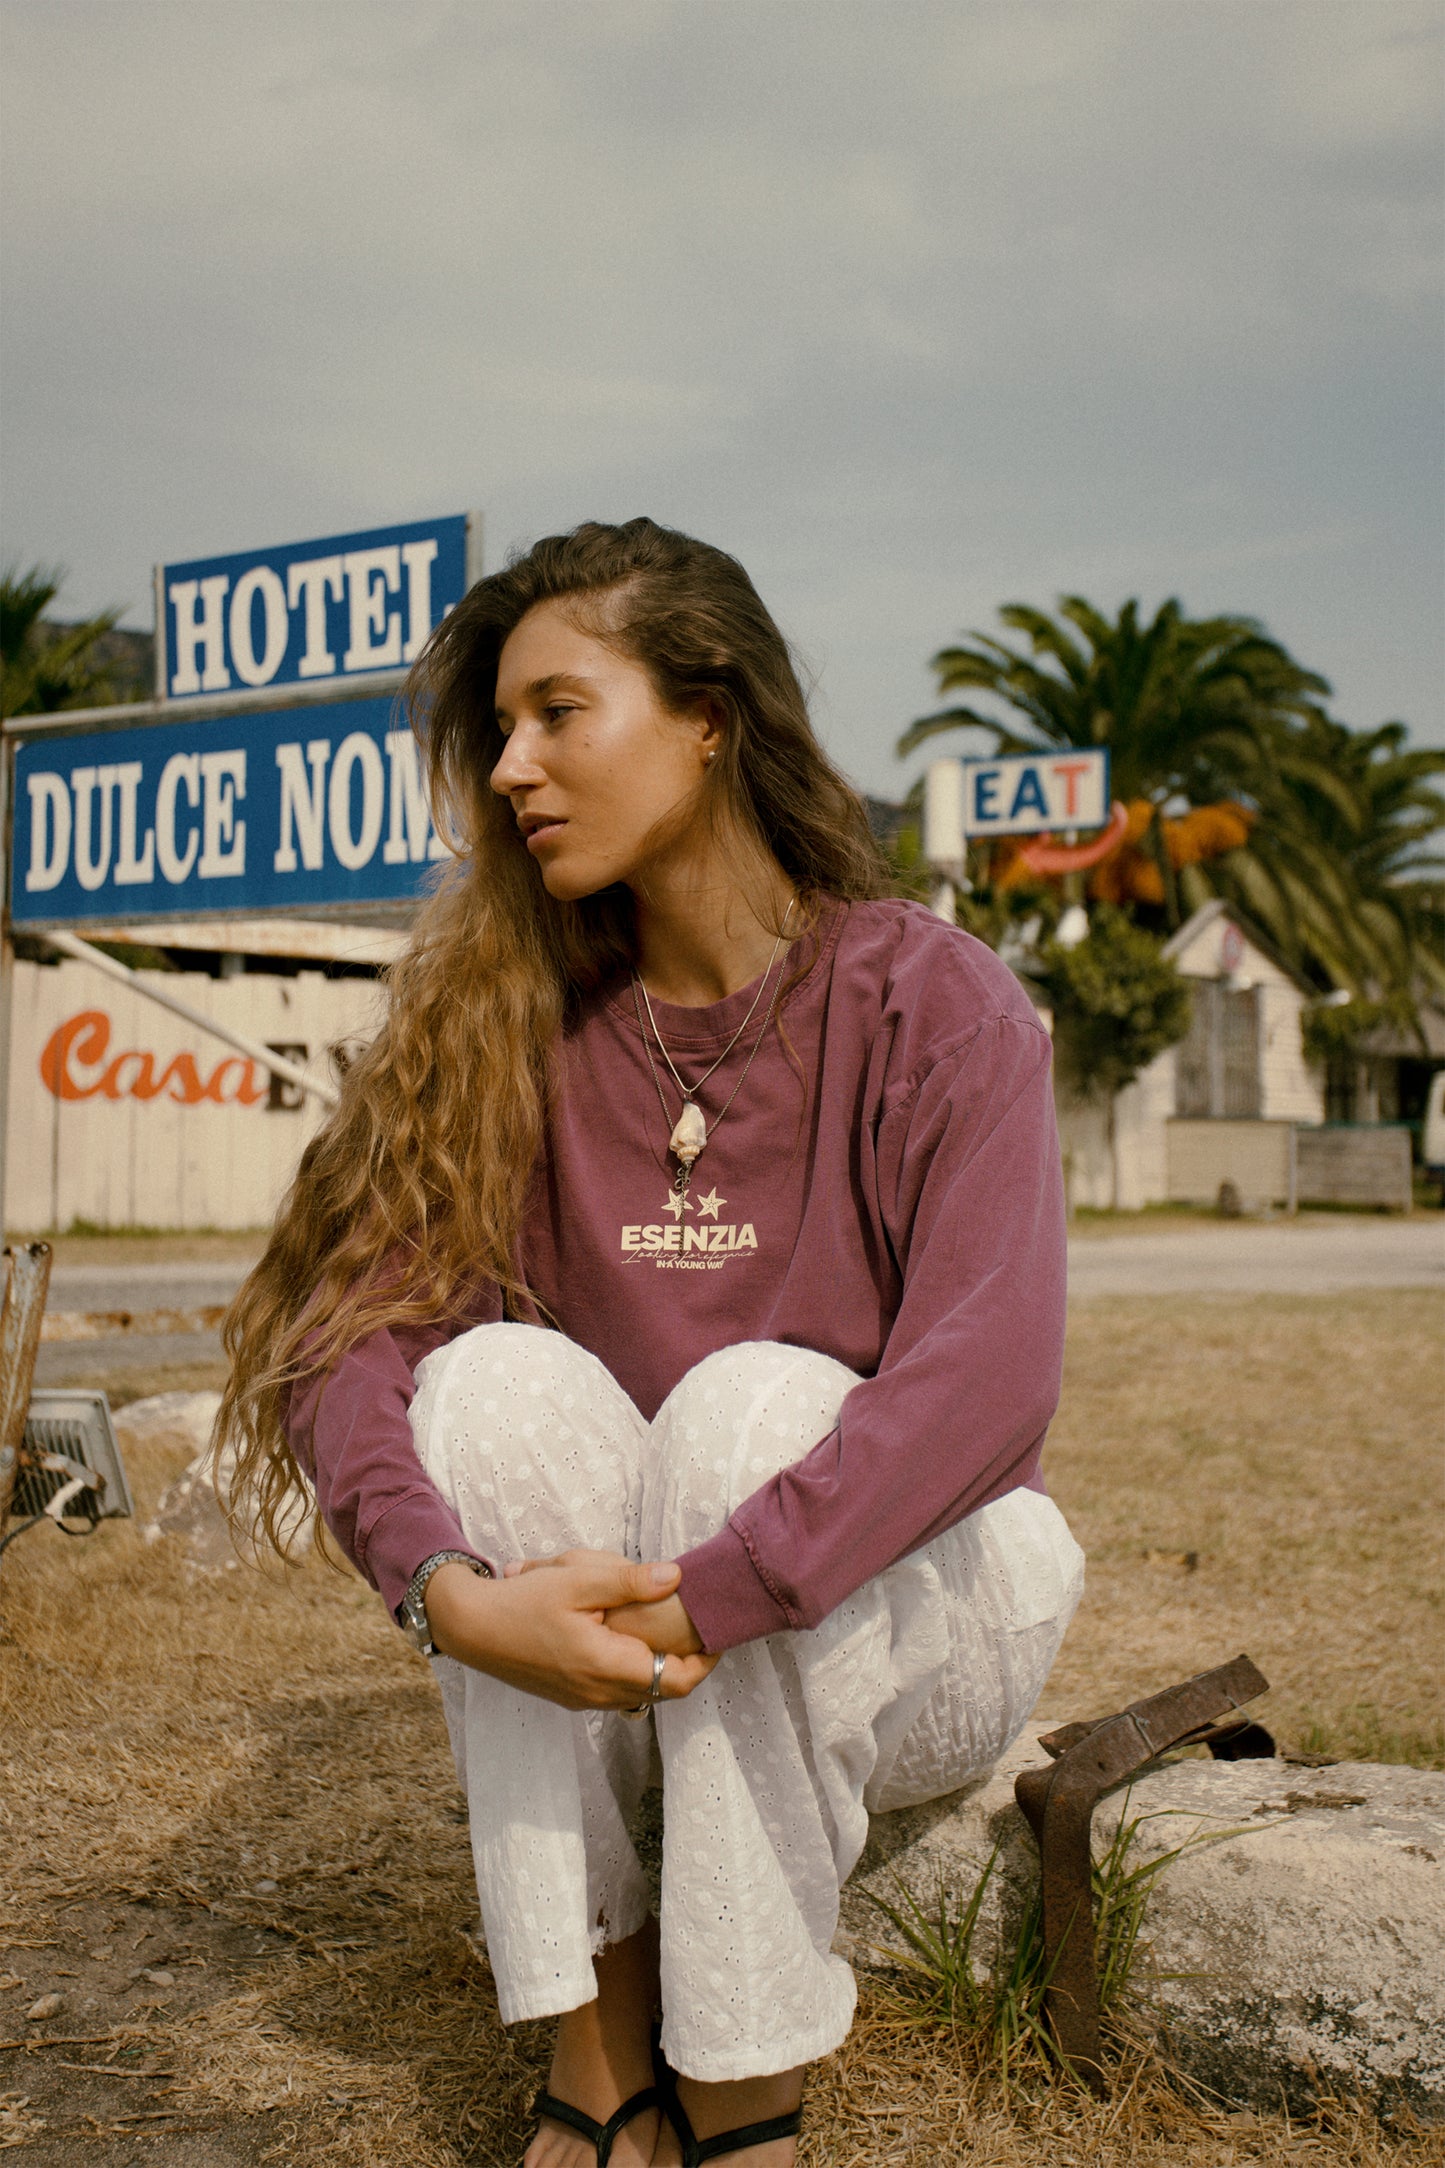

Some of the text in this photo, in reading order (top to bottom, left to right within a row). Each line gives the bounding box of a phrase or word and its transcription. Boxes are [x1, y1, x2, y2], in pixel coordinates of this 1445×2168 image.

[169, 538, 457, 696] HOTEL
[25, 748, 247, 892] DULCE
[974, 762, 1091, 822] EAT
[39, 1009, 270, 1106] Casa
[620, 1223, 759, 1252] ESENZIA
[656, 1260, 725, 1270] IN A YOUNG WAY
